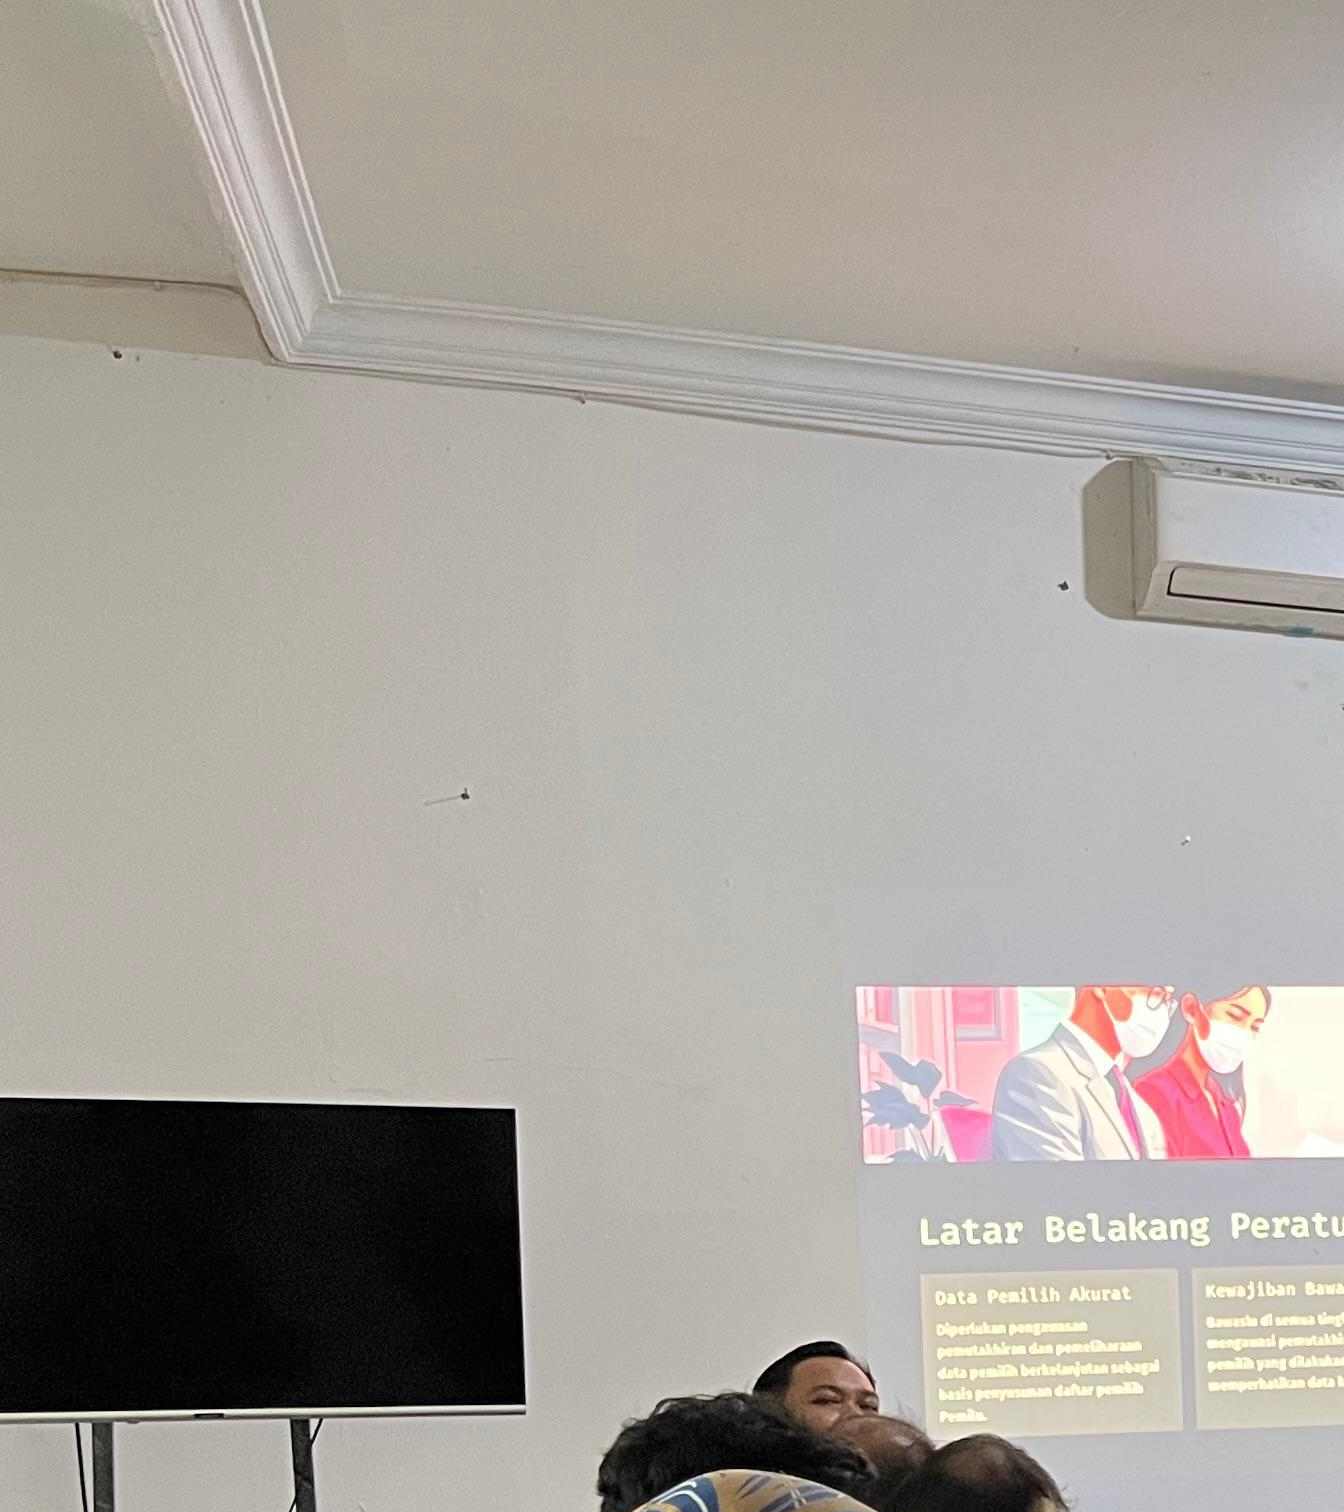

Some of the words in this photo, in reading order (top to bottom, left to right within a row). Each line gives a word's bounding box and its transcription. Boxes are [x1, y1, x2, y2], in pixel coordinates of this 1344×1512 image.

[920, 1217, 1024, 1247] Latar
[1045, 1213, 1211, 1246] Belakang
[935, 1290, 977, 1306] Data
[987, 1286, 1061, 1304] Pemilih
[1069, 1285, 1132, 1302] Akurat
[1205, 1281, 1296, 1301] Kewajiban
[937, 1366, 968, 1380] data
[1306, 1375, 1336, 1388] data
